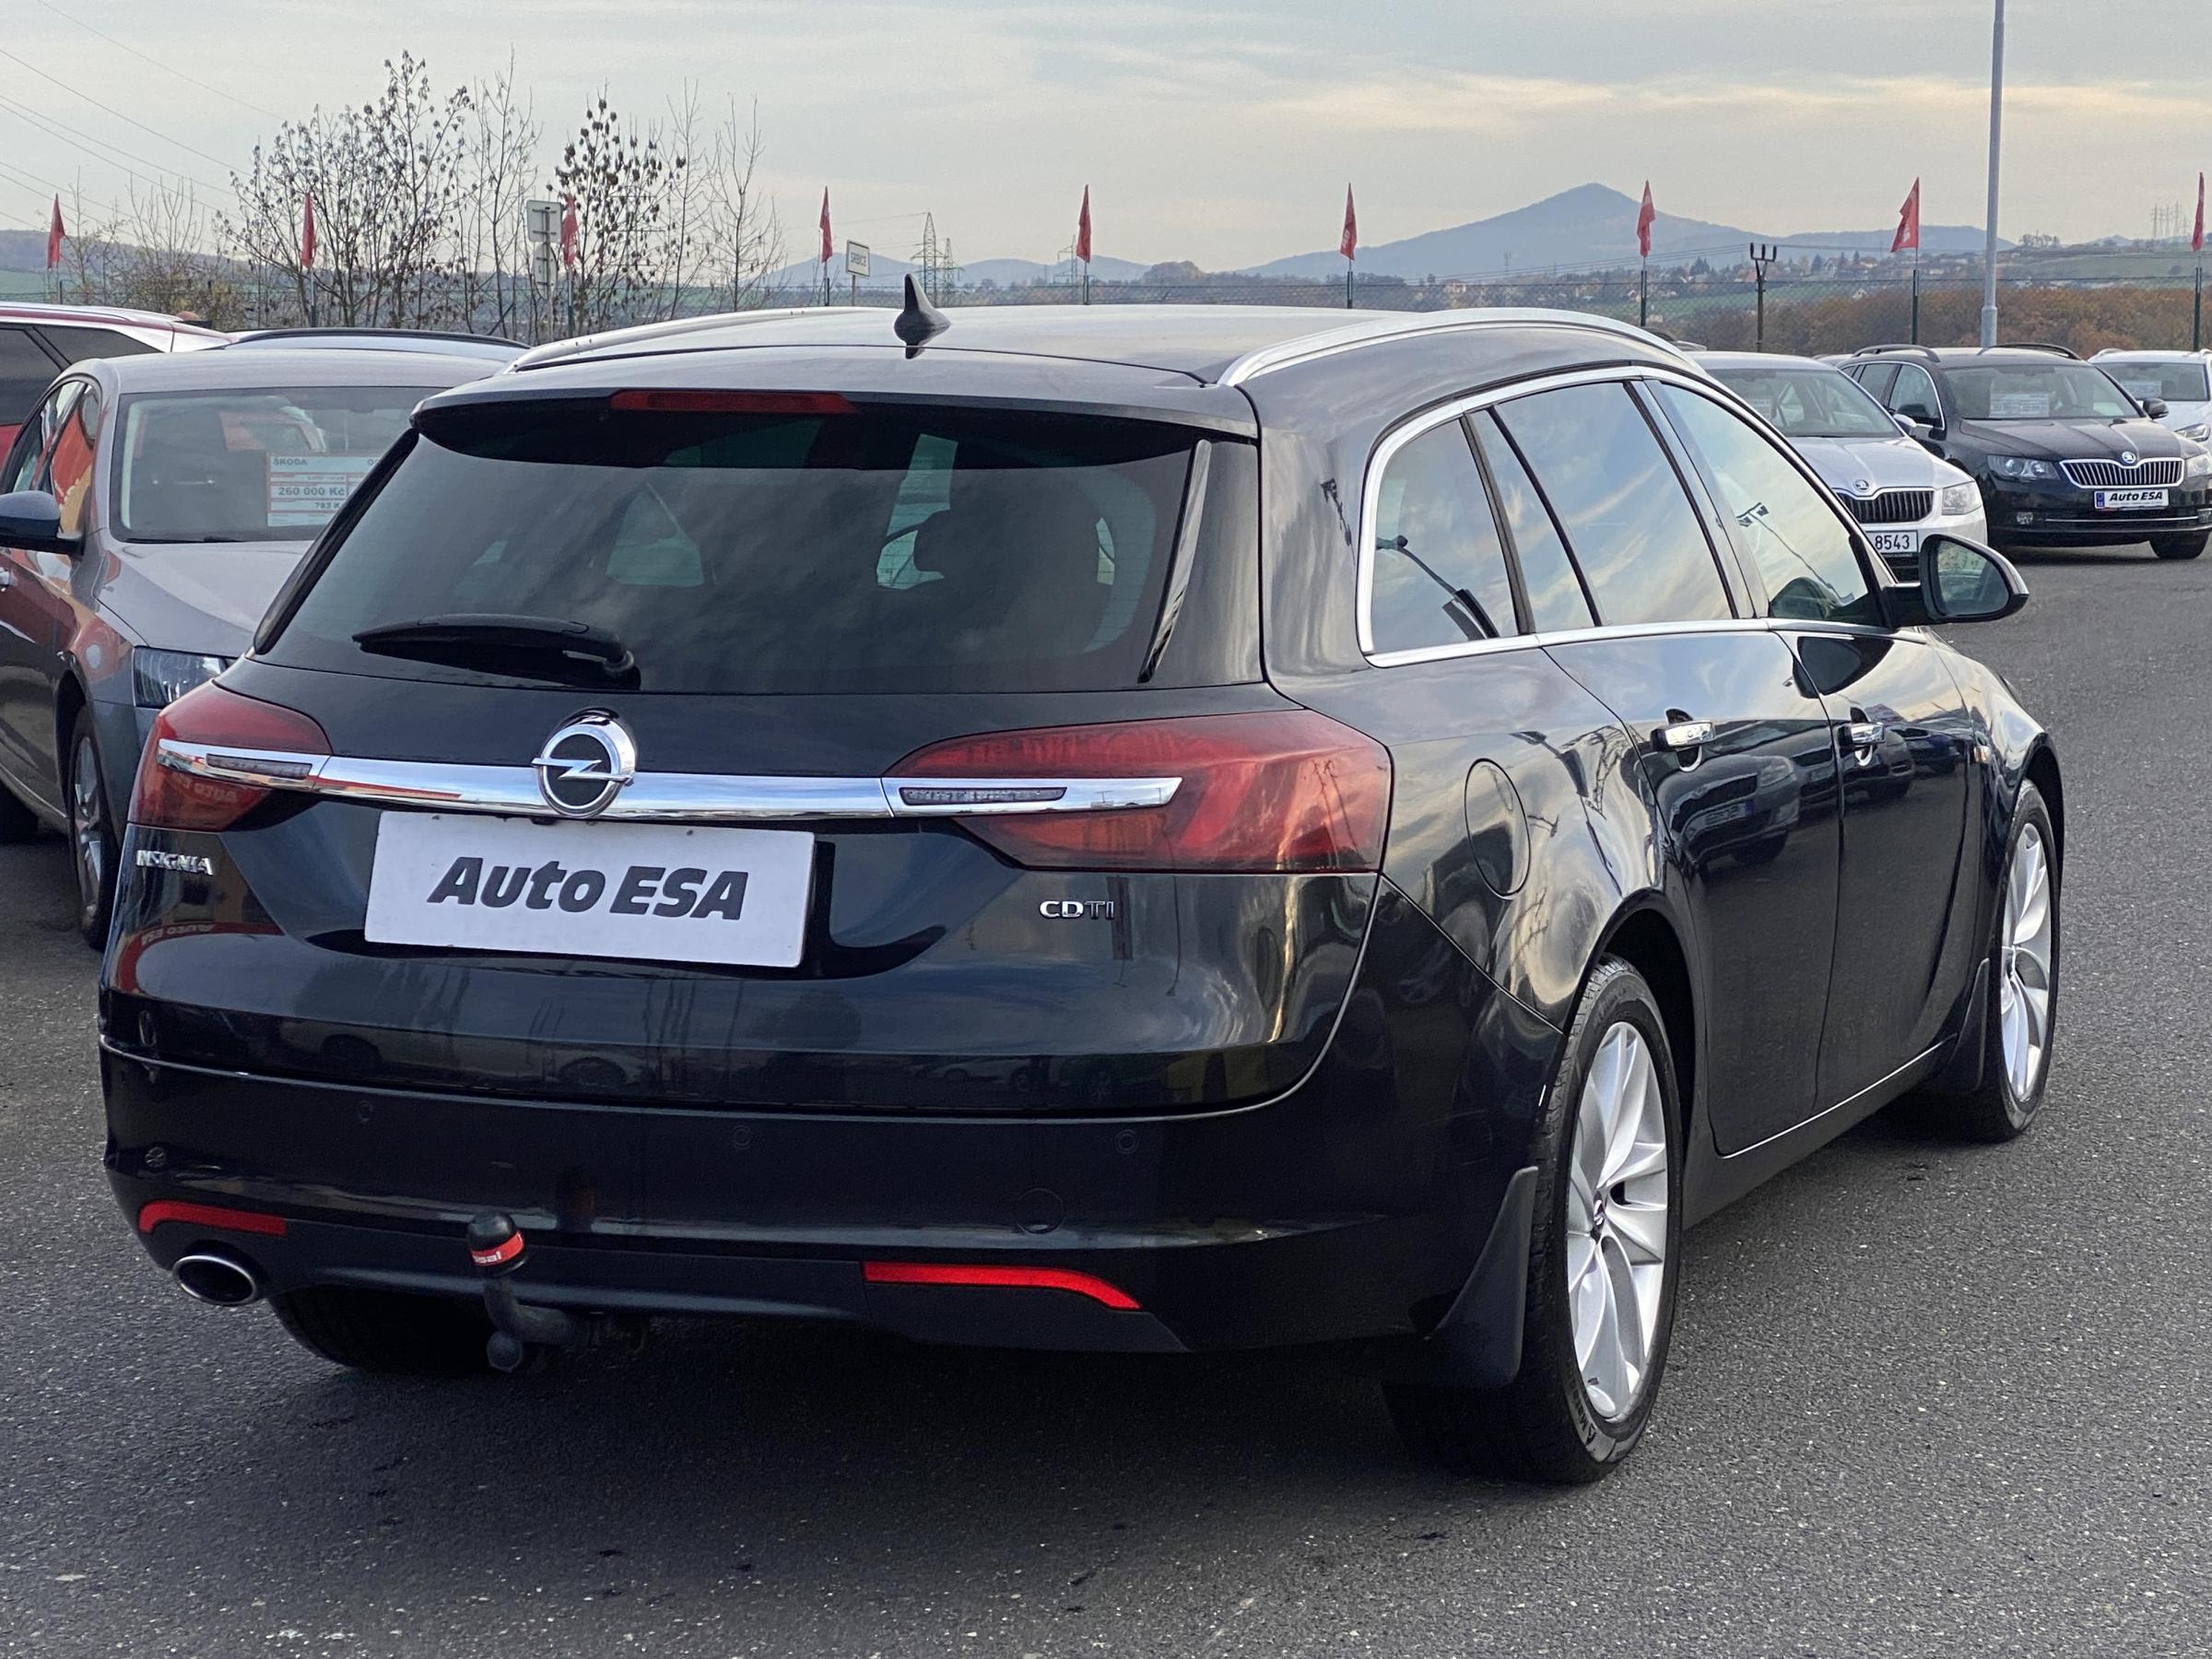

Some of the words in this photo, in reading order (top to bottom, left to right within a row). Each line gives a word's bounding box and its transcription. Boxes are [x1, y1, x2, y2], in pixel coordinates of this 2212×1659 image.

[278, 487, 300, 496] 260
[303, 487, 324, 496] 000
[2109, 492, 2139, 501] Auto
[2141, 491, 2163, 500] ESA
[1875, 535, 1910, 550] 8543
[426, 856, 606, 912] Auto
[609, 865, 748, 921] ESA
[1039, 900, 1114, 920] CDTI
